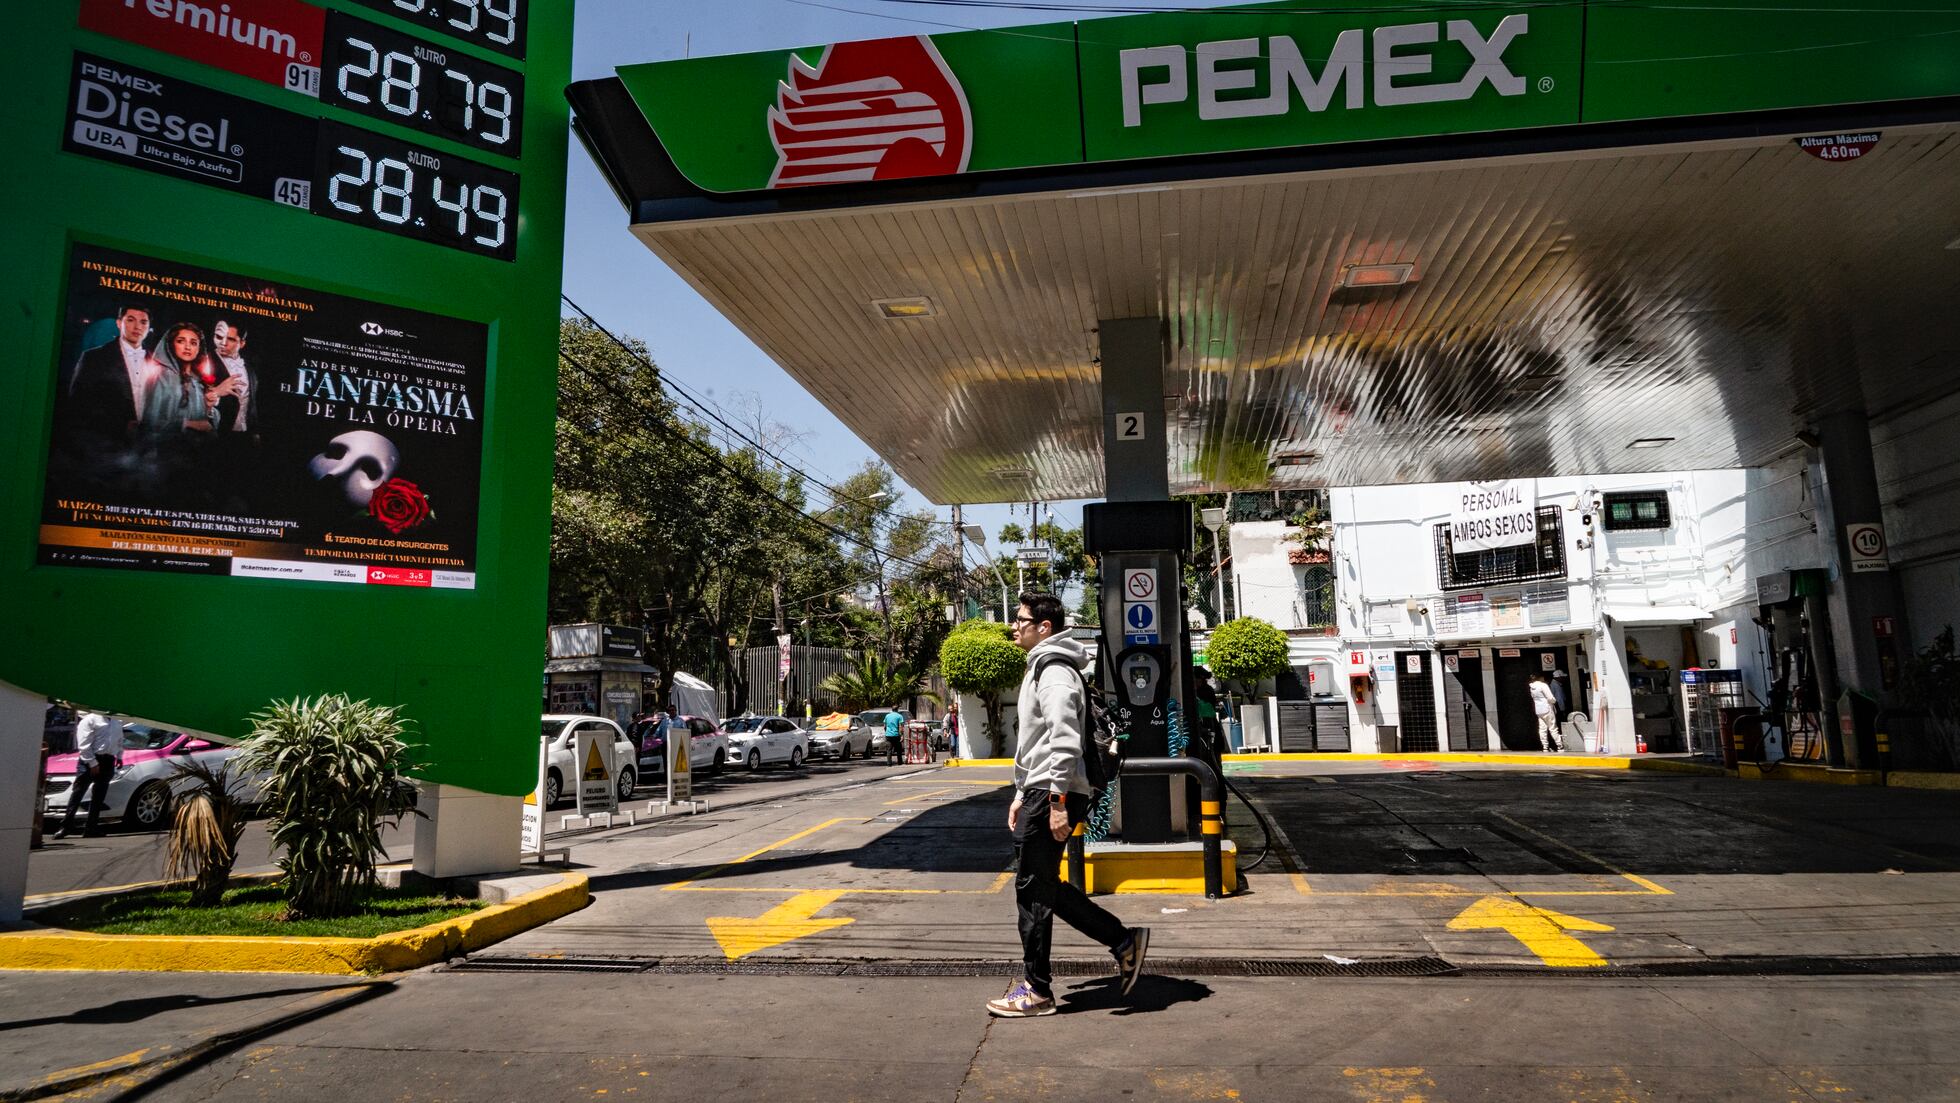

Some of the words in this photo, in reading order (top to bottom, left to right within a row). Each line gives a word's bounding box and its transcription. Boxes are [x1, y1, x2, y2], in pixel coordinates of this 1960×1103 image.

[125, 0, 295, 58] emium
[414, 45, 446, 66] $/LITRO
[81, 62, 163, 96] PEMEX
[289, 64, 310, 90] 91
[1120, 14, 1528, 127] PEMEX
[338, 37, 511, 144] 28.79
[76, 79, 230, 153] Diesel
[85, 127, 127, 149] UBA
[1801, 137, 1834, 147] Altura
[1836, 133, 1878, 145] Máxima
[143, 144, 170, 159] Ultra
[172, 152, 196, 166] Bajo
[198, 159, 233, 175] Azufre
[407, 151, 440, 171] $/LITRO
[278, 181, 301, 206] 45
[328, 145, 507, 248] 28.49
[82, 260, 104, 272] HAY
[104, 265, 159, 282] HISTORIAS
[196, 282, 253, 300] RECUERDAN
[255, 293, 280, 305] TODA
[292, 300, 314, 312] VIDA
[99, 276, 151, 294] MARZO
[151, 287, 164, 296] ES
[165, 290, 191, 302] PARA
[231, 303, 275, 318] HISTORIA
[384, 328, 404, 338] HSBC
[300, 358, 360, 374] ANDREW
[366, 368, 409, 383] LLOYD
[416, 376, 467, 392] WEBBER
[294, 367, 475, 420] FANTASMA
[306, 401, 337, 419] DE
[348, 407, 376, 424] LA
[386, 409, 457, 435] ÓPERA
[1124, 416, 1138, 436] 2
[1462, 486, 1522, 513] PERSONAL
[172, 520, 190, 528] LUN
[201, 522, 215, 530] DE
[1453, 518, 1492, 543] AMBOS
[1494, 512, 1534, 537] SEXOS
[112, 541, 131, 550] DEL
[143, 542, 156, 551] DE
[156, 543, 177, 553] MAR
[180, 545, 191, 554] AL
[201, 547, 214, 555] DE
[215, 548, 233, 557] ABR
[145, 534, 174, 543] SANTO
[334, 535, 366, 545] TEATRO
[379, 539, 395, 547] LOS
[396, 540, 449, 551] INSURGENTES
[1860, 533, 1878, 546] 10
[240, 564, 304, 573] ticketmaster.com.mx
[304, 548, 359, 559] TEMPORADA
[427, 557, 465, 567] LIMITADA
